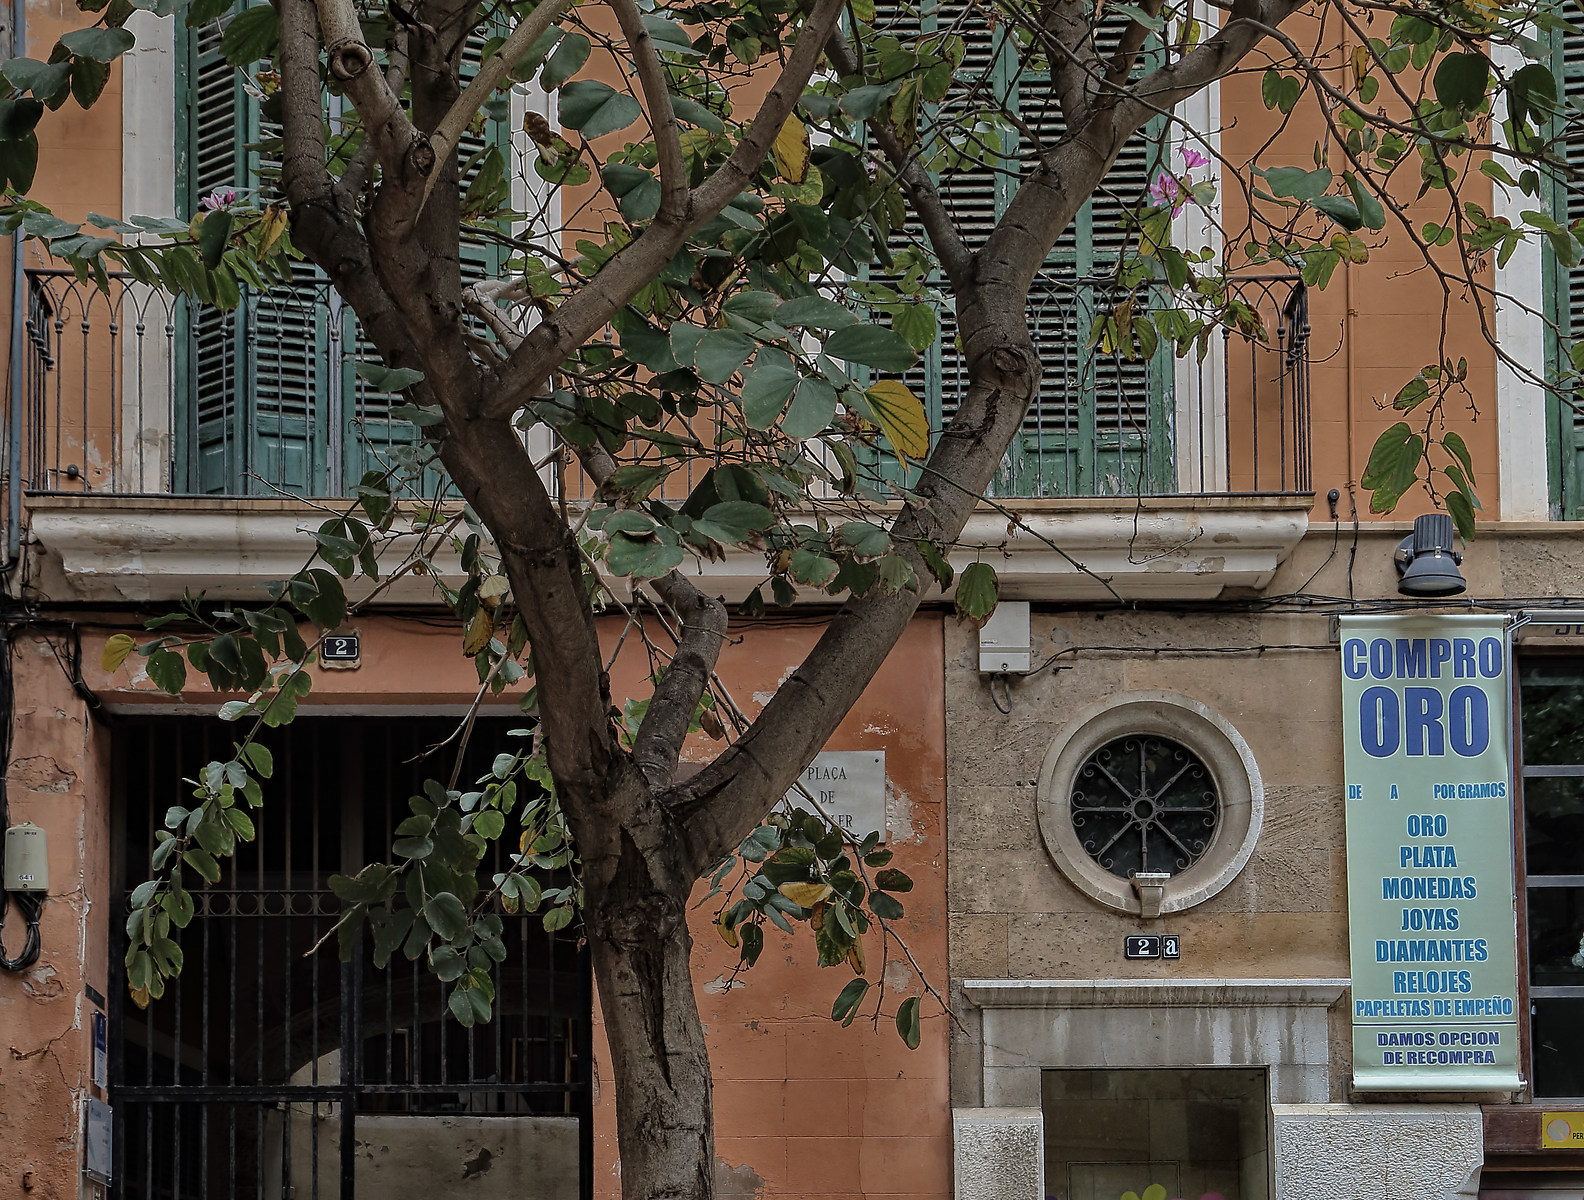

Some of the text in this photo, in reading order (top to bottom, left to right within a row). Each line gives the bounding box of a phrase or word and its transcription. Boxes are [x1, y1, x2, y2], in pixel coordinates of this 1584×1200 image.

[335, 639, 347, 655] 2
[1343, 636, 1503, 680] COMPRO
[1359, 685, 1490, 758] ORO
[807, 766, 847, 781] PLAÇA
[820, 790, 835, 804] DE
[1348, 782, 1506, 799] DE A POR GRAMOS
[1407, 814, 1447, 837] ORO
[1400, 846, 1457, 868] PLATA
[1382, 876, 1477, 900] MONEDAS
[1401, 908, 1459, 931] JOYAS
[1138, 939, 1178, 955] 2 a
[1375, 938, 1488, 962] DIAMANTES
[1393, 970, 1472, 994] RELOJES
[1355, 995, 1513, 1017] PAPELETAS DE EMPEÑO
[1377, 1031, 1499, 1047] DAMOS OPCION
[1383, 1050, 1496, 1065] DE RECOMPRA
